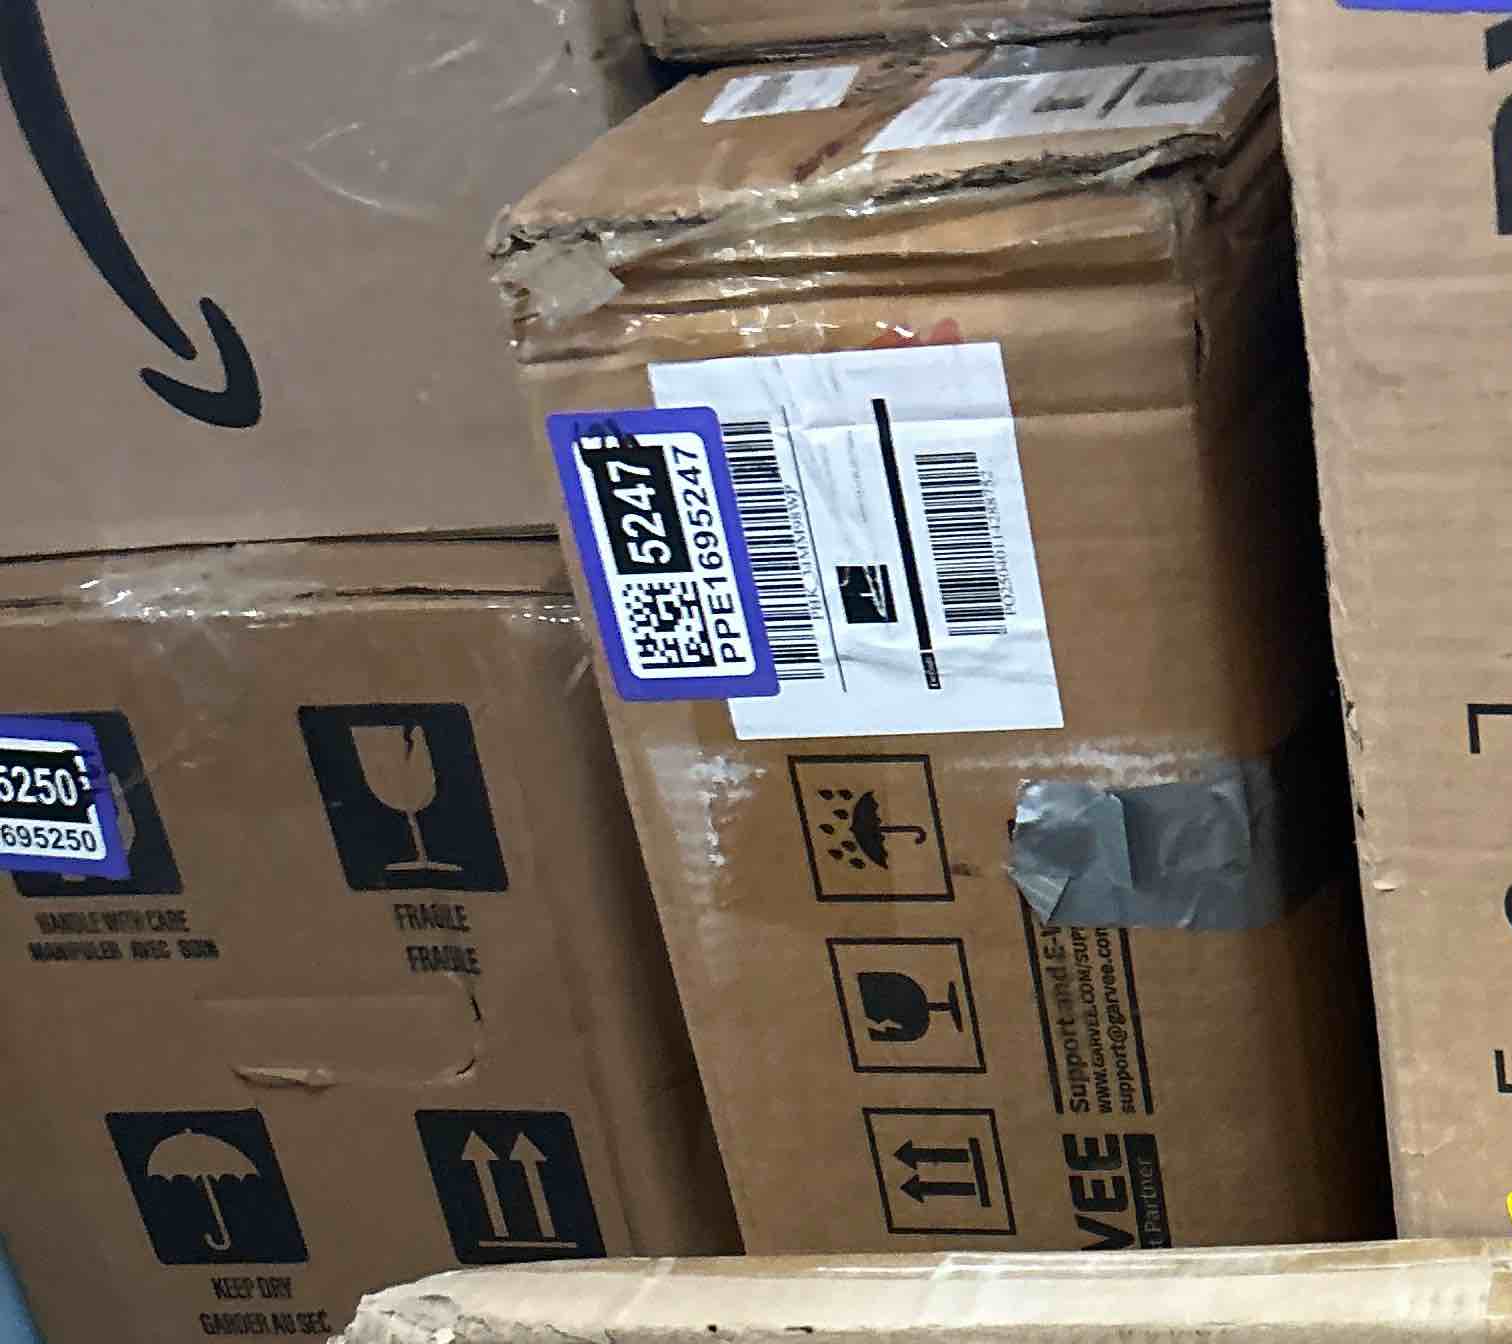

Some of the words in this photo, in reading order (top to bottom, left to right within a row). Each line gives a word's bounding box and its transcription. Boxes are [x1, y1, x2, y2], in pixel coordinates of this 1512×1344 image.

[607, 459, 674, 567] 5247
[673, 445, 747, 665] PPE1695247
[0, 764, 79, 808] 5250
[0, 823, 97, 852] 695250
